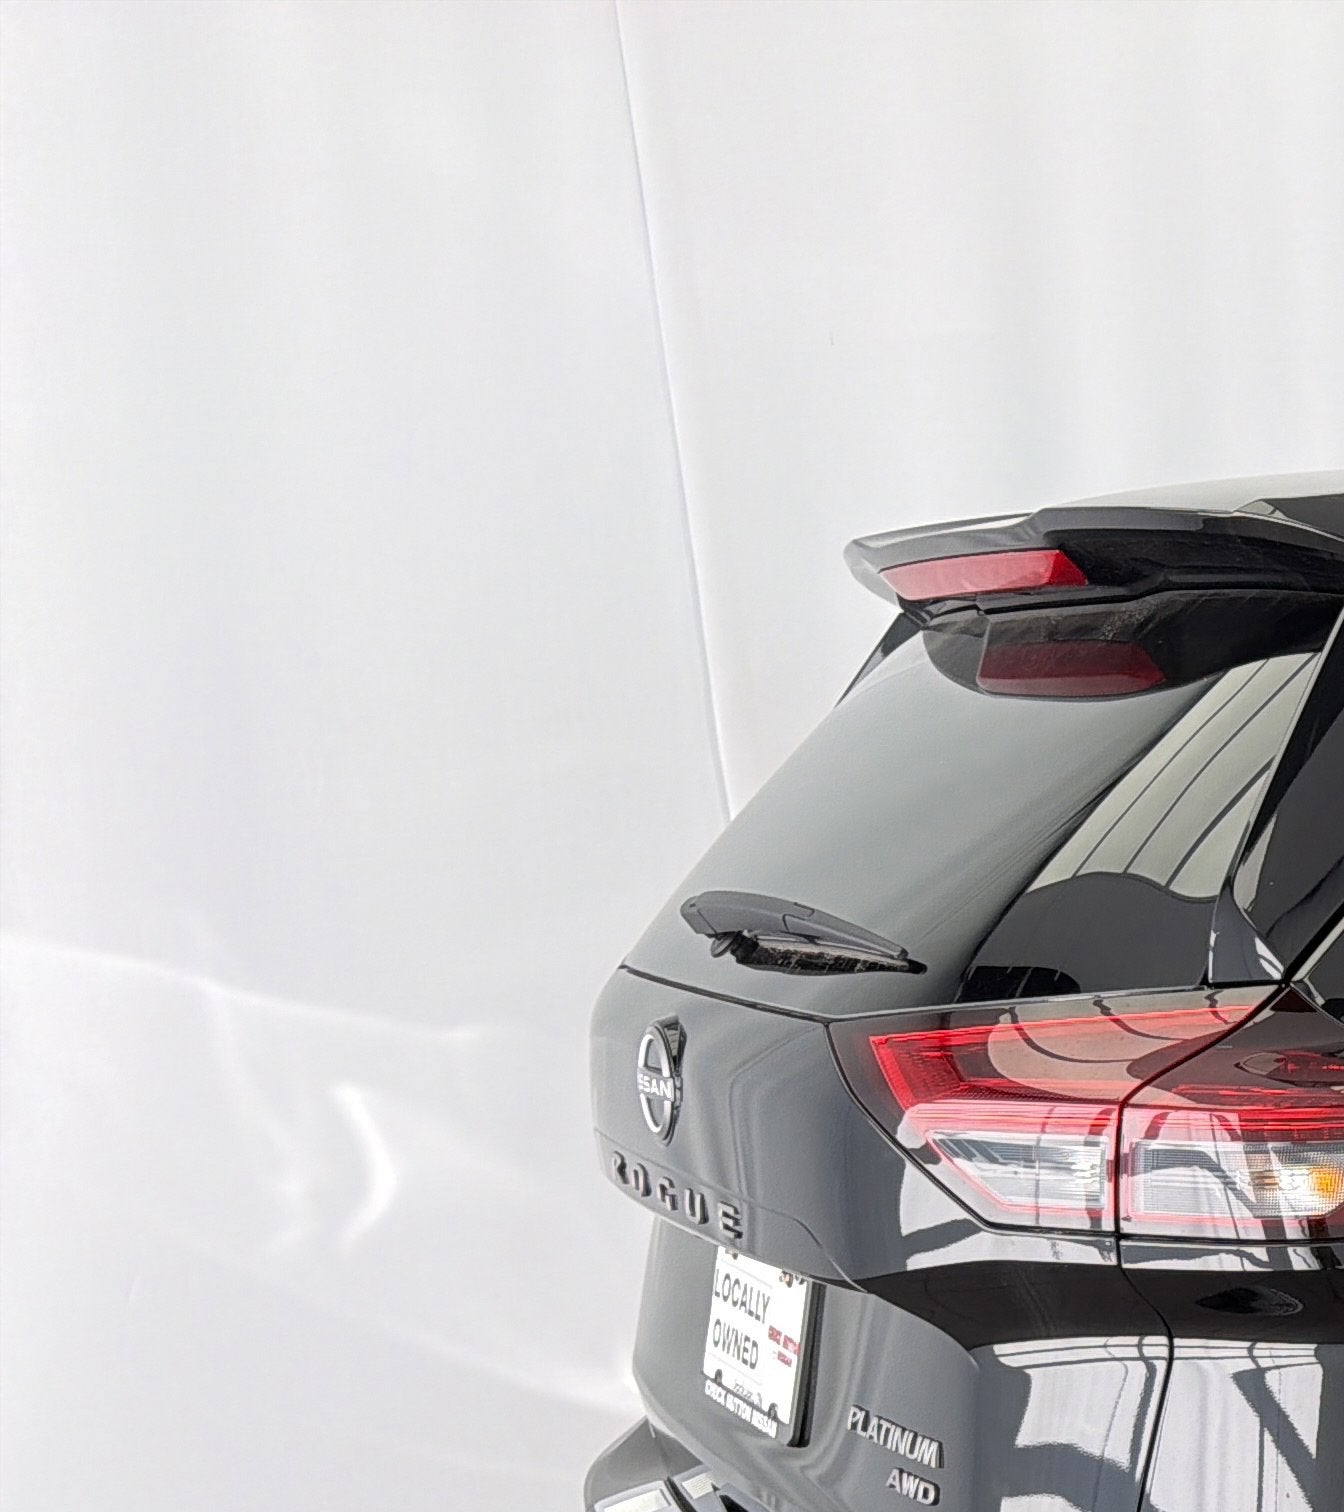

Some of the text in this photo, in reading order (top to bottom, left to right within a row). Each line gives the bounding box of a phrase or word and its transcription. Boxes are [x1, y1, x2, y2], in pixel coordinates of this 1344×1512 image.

[612, 1150, 743, 1239] ROGUE
[713, 1269, 771, 1324] LOCALLY
[713, 1319, 759, 1370] OWNED
[847, 1405, 943, 1468] PLATINUM
[886, 1468, 940, 1505] AWD
